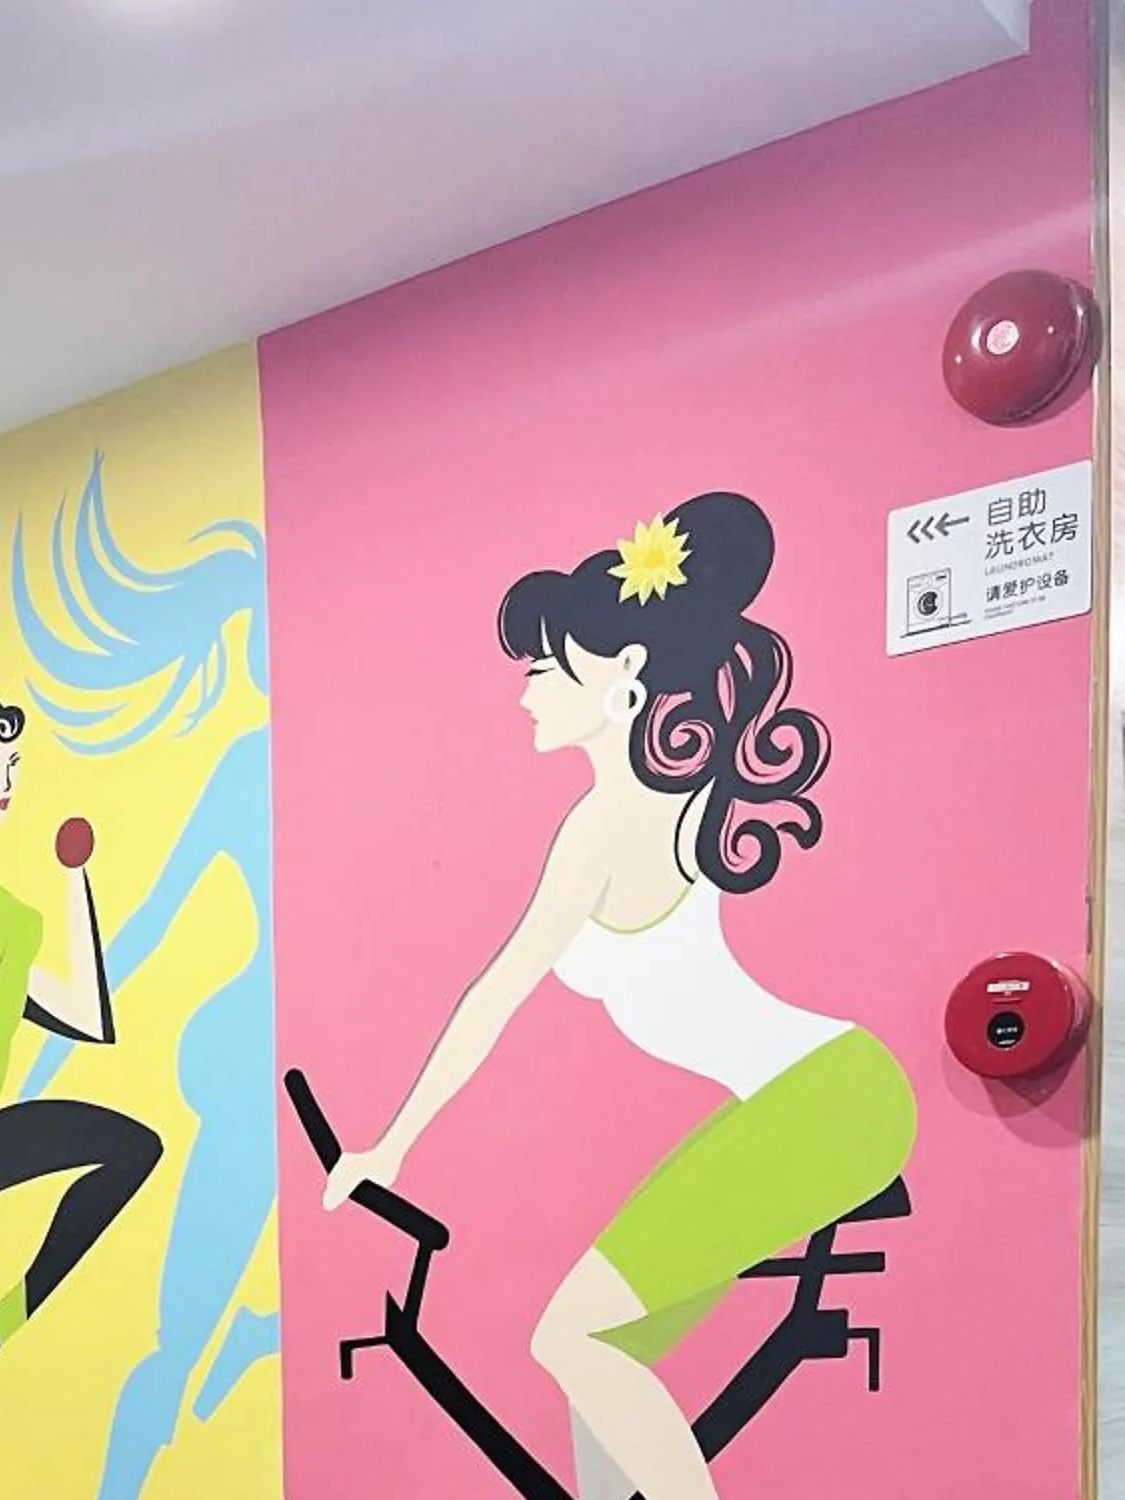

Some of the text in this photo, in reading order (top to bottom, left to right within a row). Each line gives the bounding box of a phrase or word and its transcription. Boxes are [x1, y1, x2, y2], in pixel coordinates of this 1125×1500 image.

[988, 488, 1046, 526] 自助
[985, 513, 1078, 559] 洗衣房
[986, 569, 1069, 603] 请爱护设备
